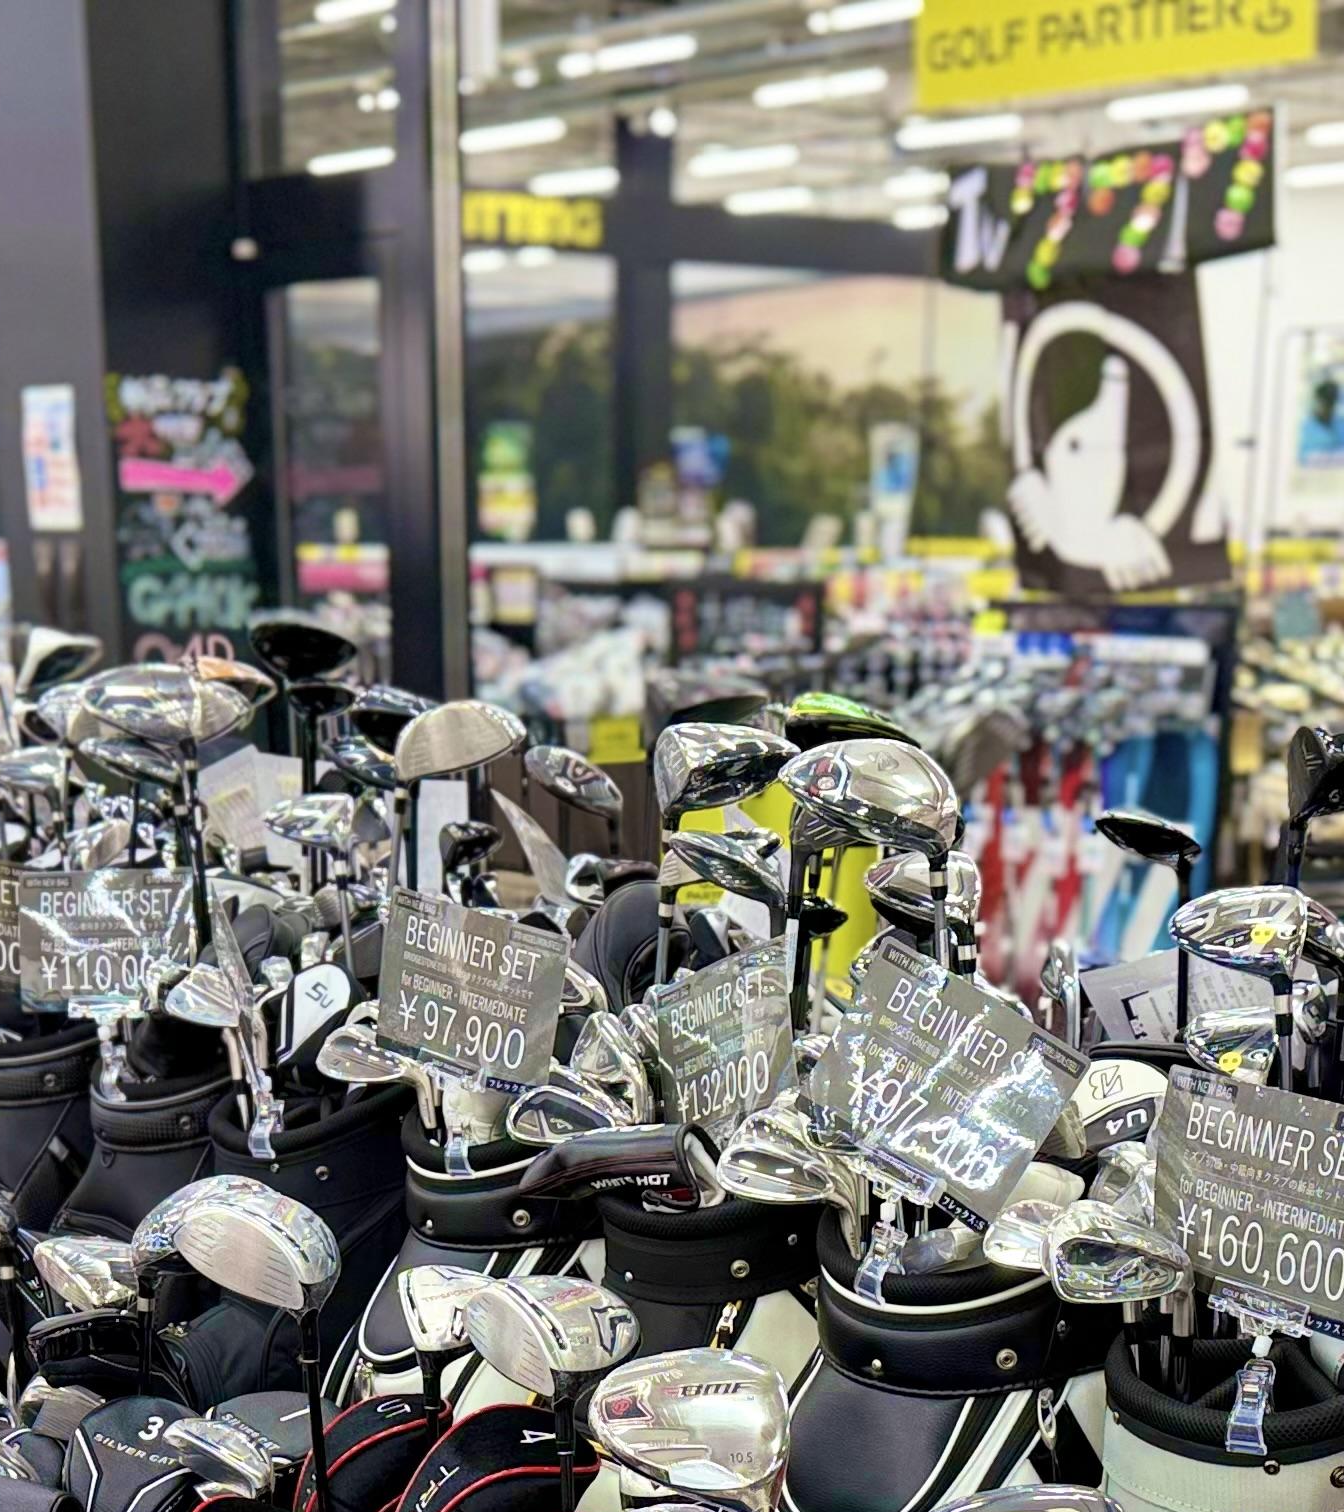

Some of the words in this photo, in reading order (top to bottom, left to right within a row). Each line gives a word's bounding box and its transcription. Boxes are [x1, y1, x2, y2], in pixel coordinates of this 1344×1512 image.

[927, 19, 1025, 73] GOLF
[139, 889, 172, 915] SET
[406, 915, 496, 971] BEGINNER
[499, 945, 541, 983] SET
[413, 973, 453, 1000] BEGINNER
[459, 990, 528, 1024] INTERMEDIATE
[670, 982, 732, 1040] BEGINNER
[736, 968, 765, 1008] SET
[886, 977, 1008, 1074] BEGINNER
[676, 1051, 769, 1123] ¥132,000
[1185, 1101, 1315, 1171] BEGINNER
[635, 1172, 670, 1187] HOT
[1195, 1177, 1253, 1214] BEGINNER
[92, 1433, 150, 1463] SILVER
[137, 1415, 165, 1442] 3
[727, 1450, 755, 1465] 10.5
